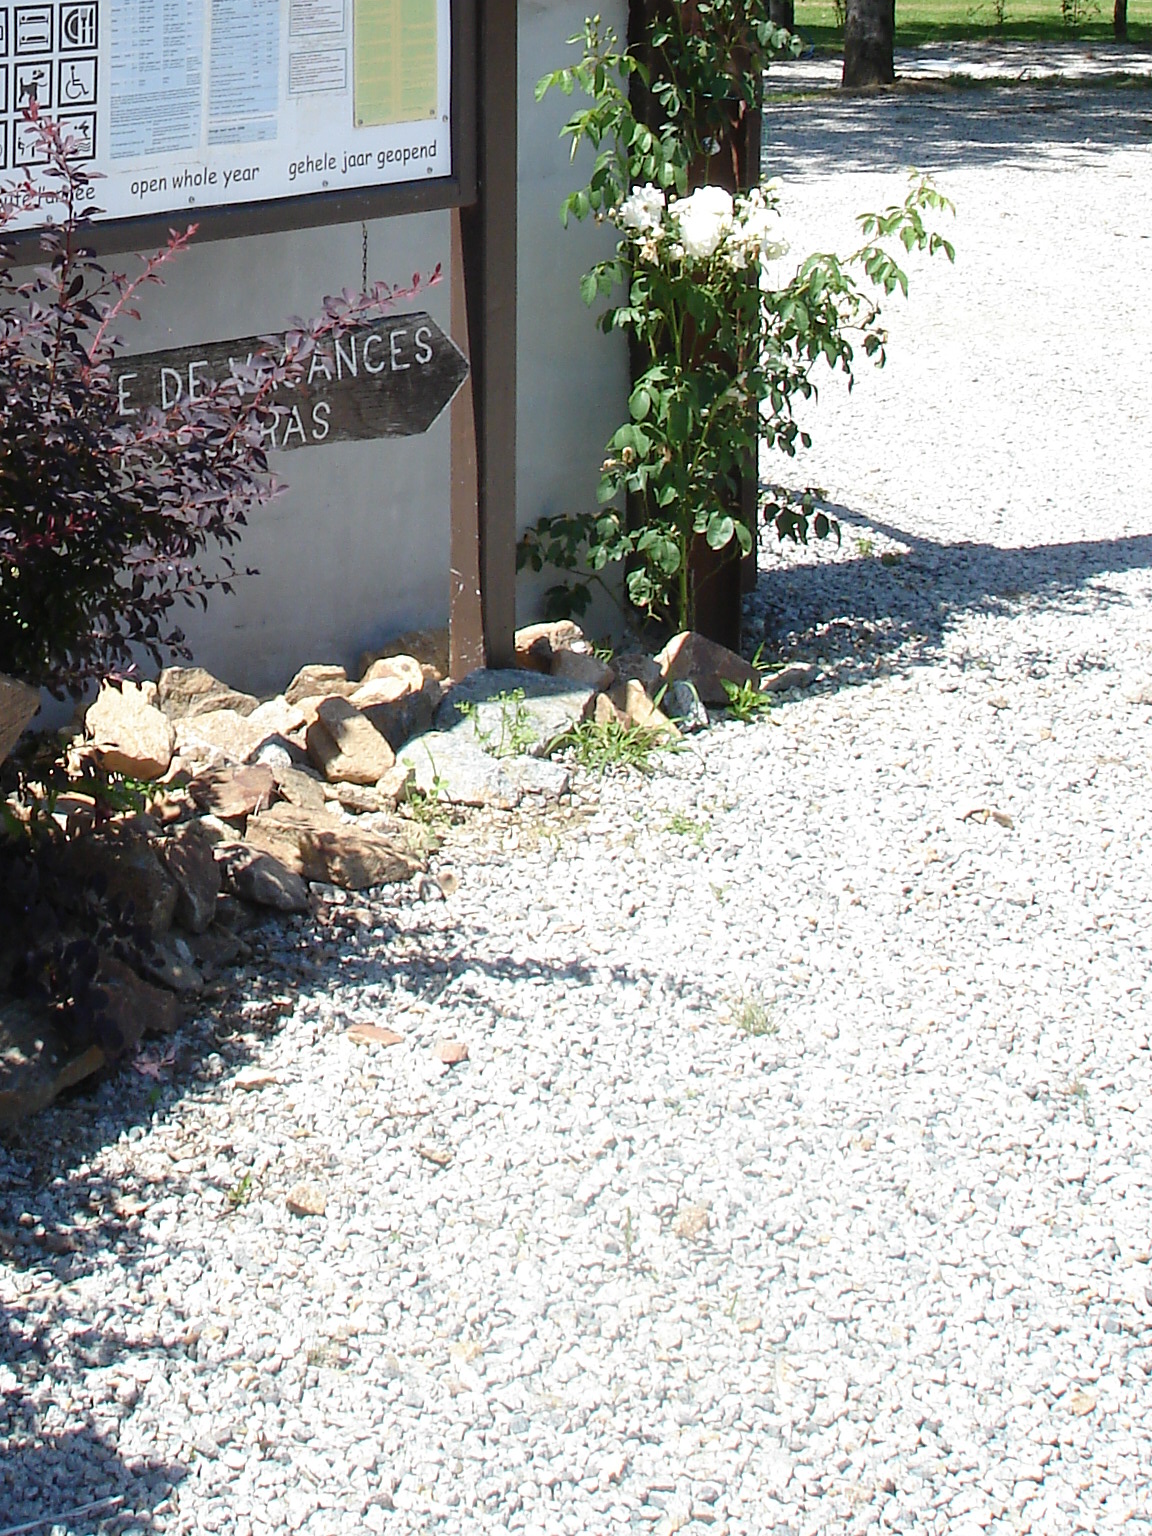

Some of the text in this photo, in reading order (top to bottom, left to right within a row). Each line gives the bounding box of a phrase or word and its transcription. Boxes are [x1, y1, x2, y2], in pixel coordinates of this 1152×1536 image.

[288, 140, 438, 181] gehele jaar geopend
[130, 165, 261, 199] open whole year
[161, 360, 209, 411] DE
